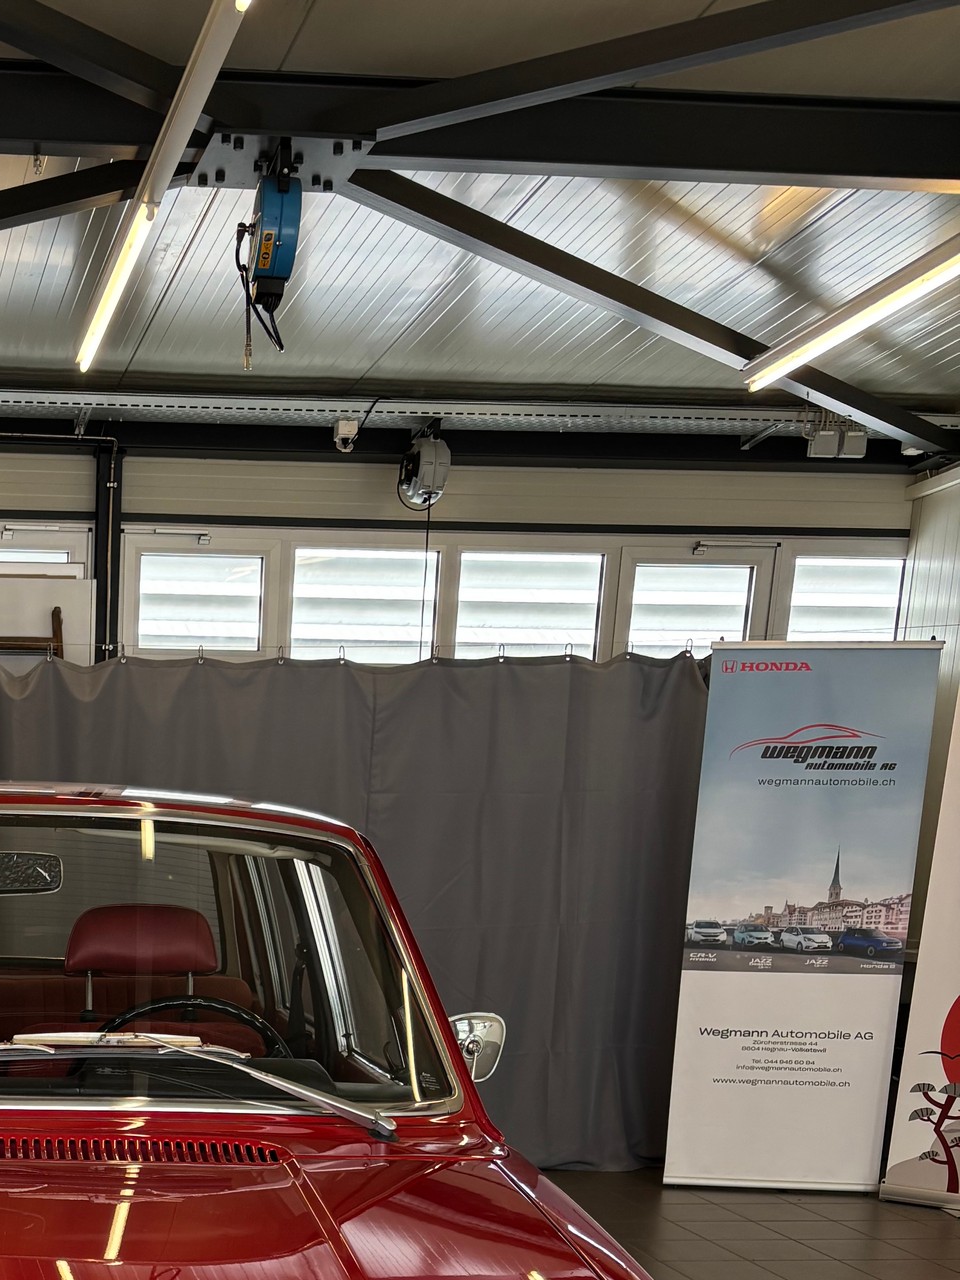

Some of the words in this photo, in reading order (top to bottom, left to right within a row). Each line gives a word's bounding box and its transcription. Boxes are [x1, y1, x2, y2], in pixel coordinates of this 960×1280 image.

[740, 662, 812, 672] HONDA
[760, 745, 877, 763] wegmann
[804, 760, 876, 771] automobile
[879, 762, 897, 771] AG
[757, 777, 896, 787] wegmannautomobile.ch
[699, 1027, 769, 1040] Wegmann
[771, 1029, 851, 1040] Automobile
[854, 1031, 874, 1040] AG
[712, 1078, 851, 1087] www.wegmannautomobile.ch
